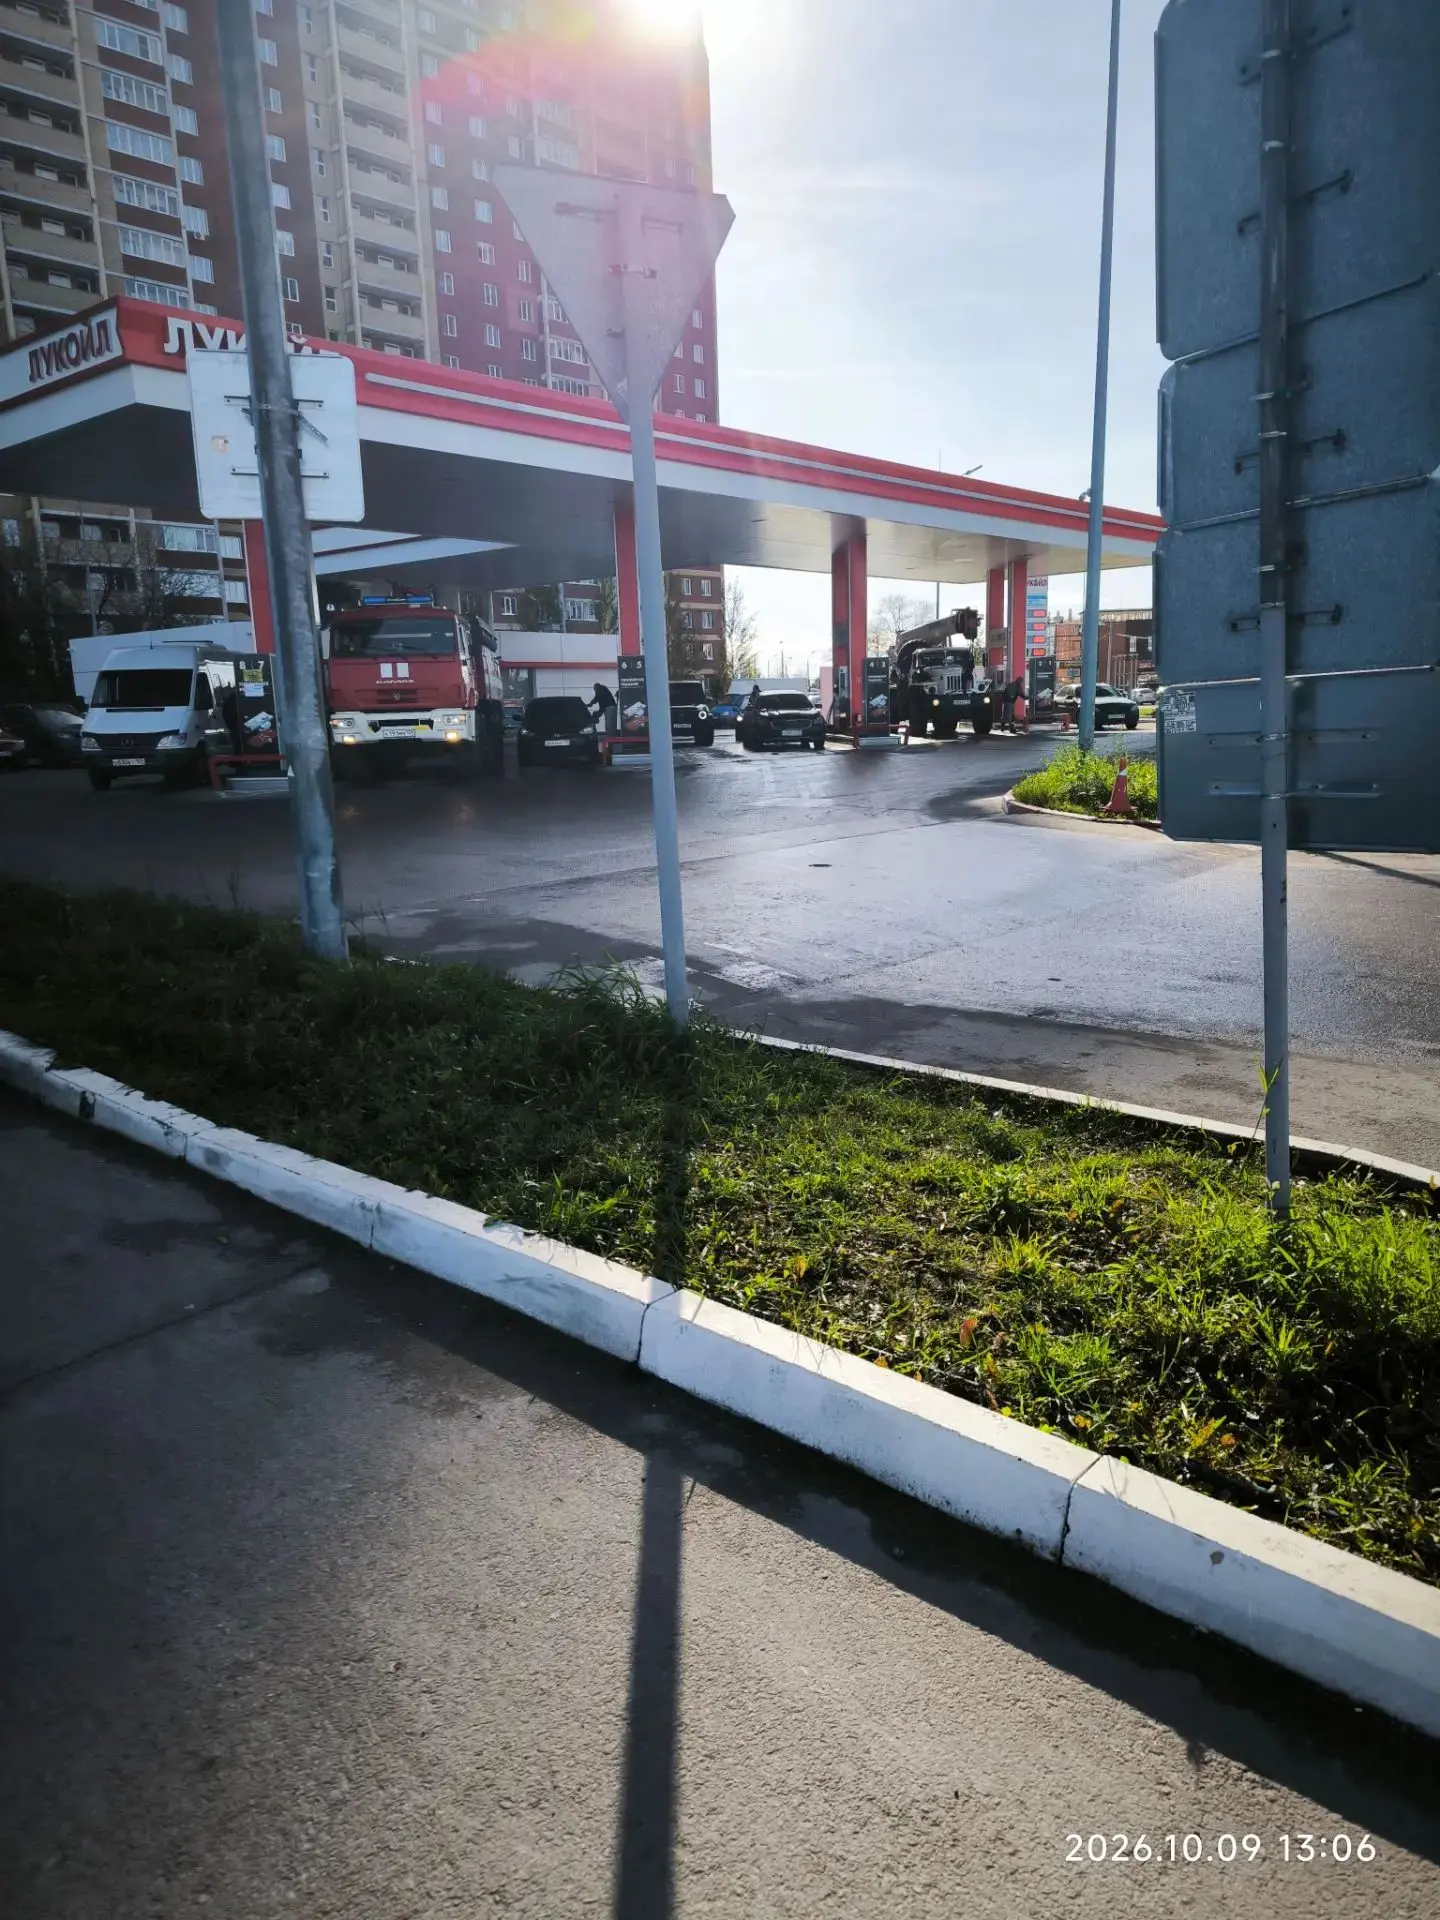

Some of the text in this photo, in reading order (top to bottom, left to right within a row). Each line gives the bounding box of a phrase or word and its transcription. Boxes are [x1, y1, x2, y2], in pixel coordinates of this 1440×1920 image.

[28, 319, 113, 382] ЛУКОЙЛ
[239, 660, 265, 670] 8 7
[621, 660, 642, 670] 6 5
